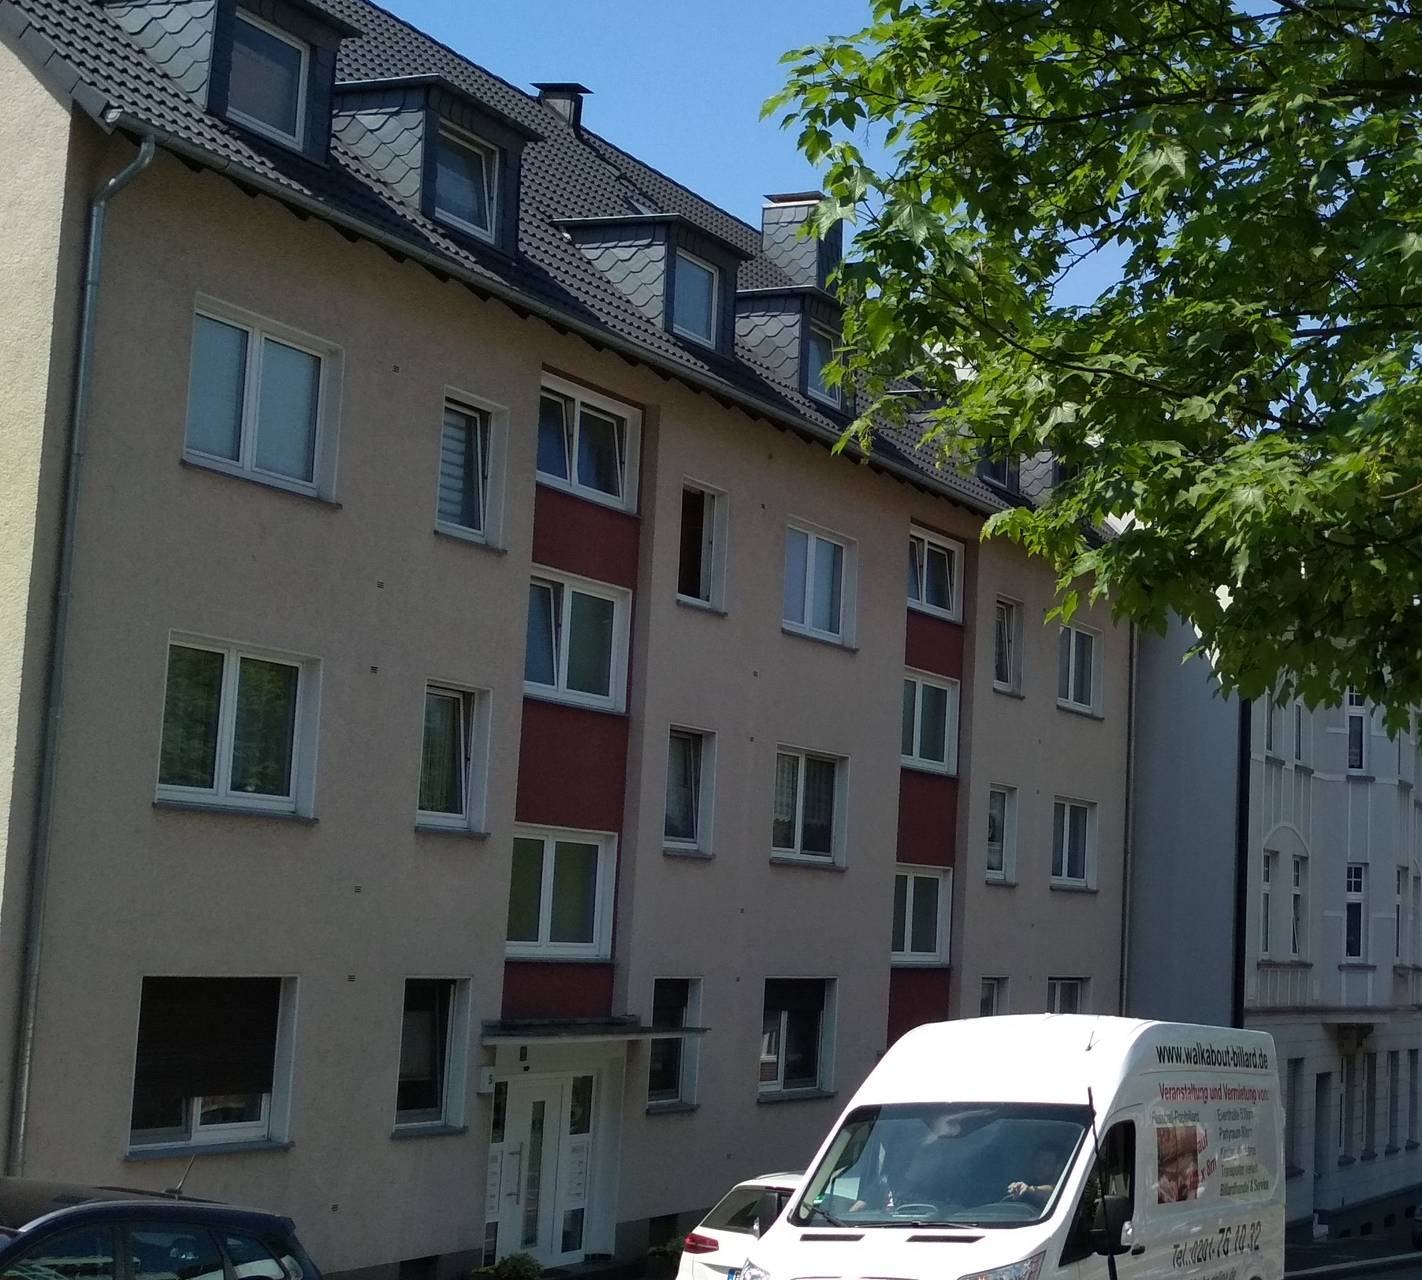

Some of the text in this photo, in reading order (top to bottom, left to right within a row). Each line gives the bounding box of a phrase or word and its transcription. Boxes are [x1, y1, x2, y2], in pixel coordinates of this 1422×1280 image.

[1156, 1042, 1268, 1069] www.walkabout-billard.de
[1159, 1083, 1208, 1104] Veranstaltung
[1210, 1083, 1221, 1100] und
[1223, 1083, 1257, 1104] Vermietung
[1234, 1224, 1246, 1252] 10
[1248, 1220, 1261, 1250] 32
